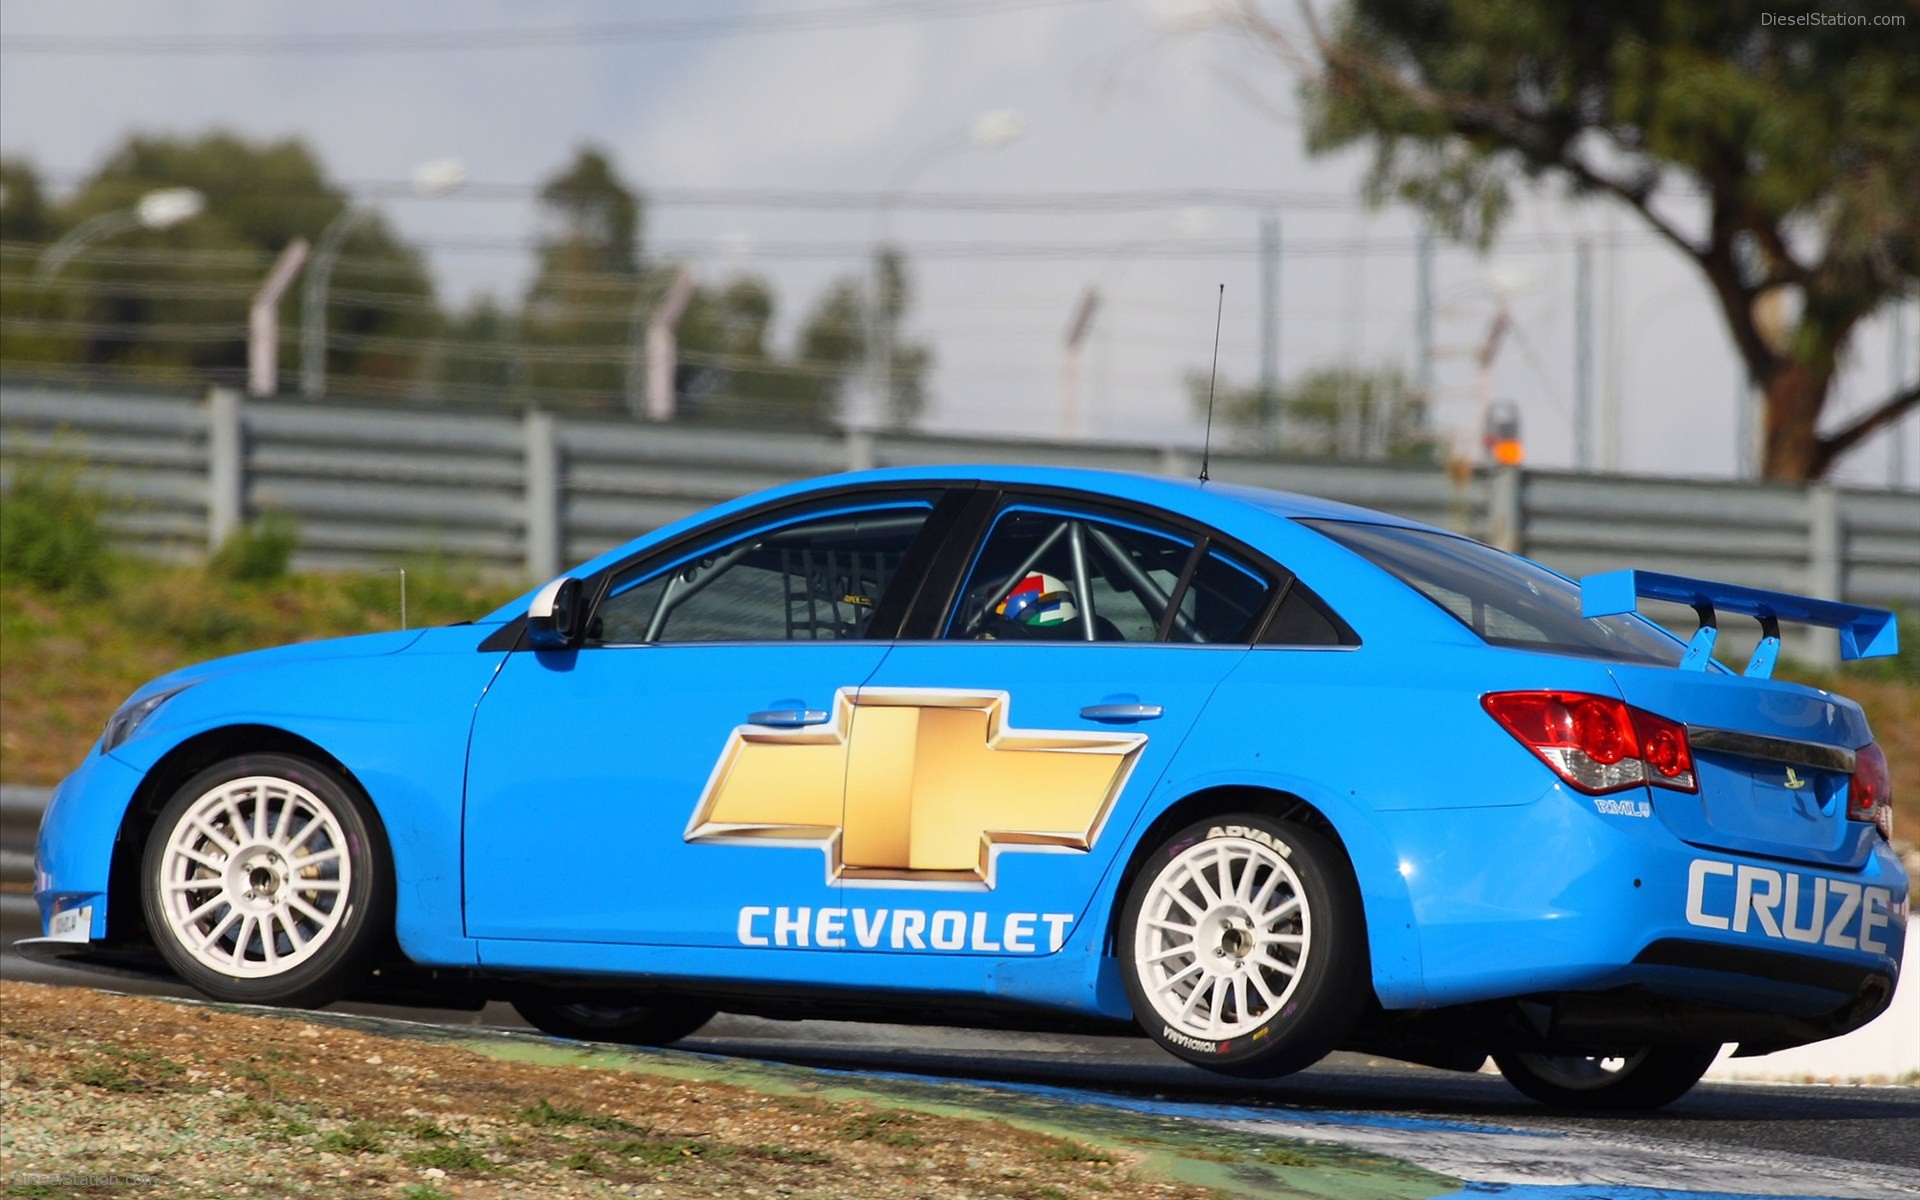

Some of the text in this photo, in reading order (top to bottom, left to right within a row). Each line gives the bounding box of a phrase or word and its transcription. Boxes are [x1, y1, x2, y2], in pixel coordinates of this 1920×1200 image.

[1206, 825, 1292, 859] ADVAN
[1686, 859, 1890, 955] CRUZE
[737, 906, 1074, 952] CHEVROLET
[1163, 1025, 1216, 1053] YOKOHAMA
